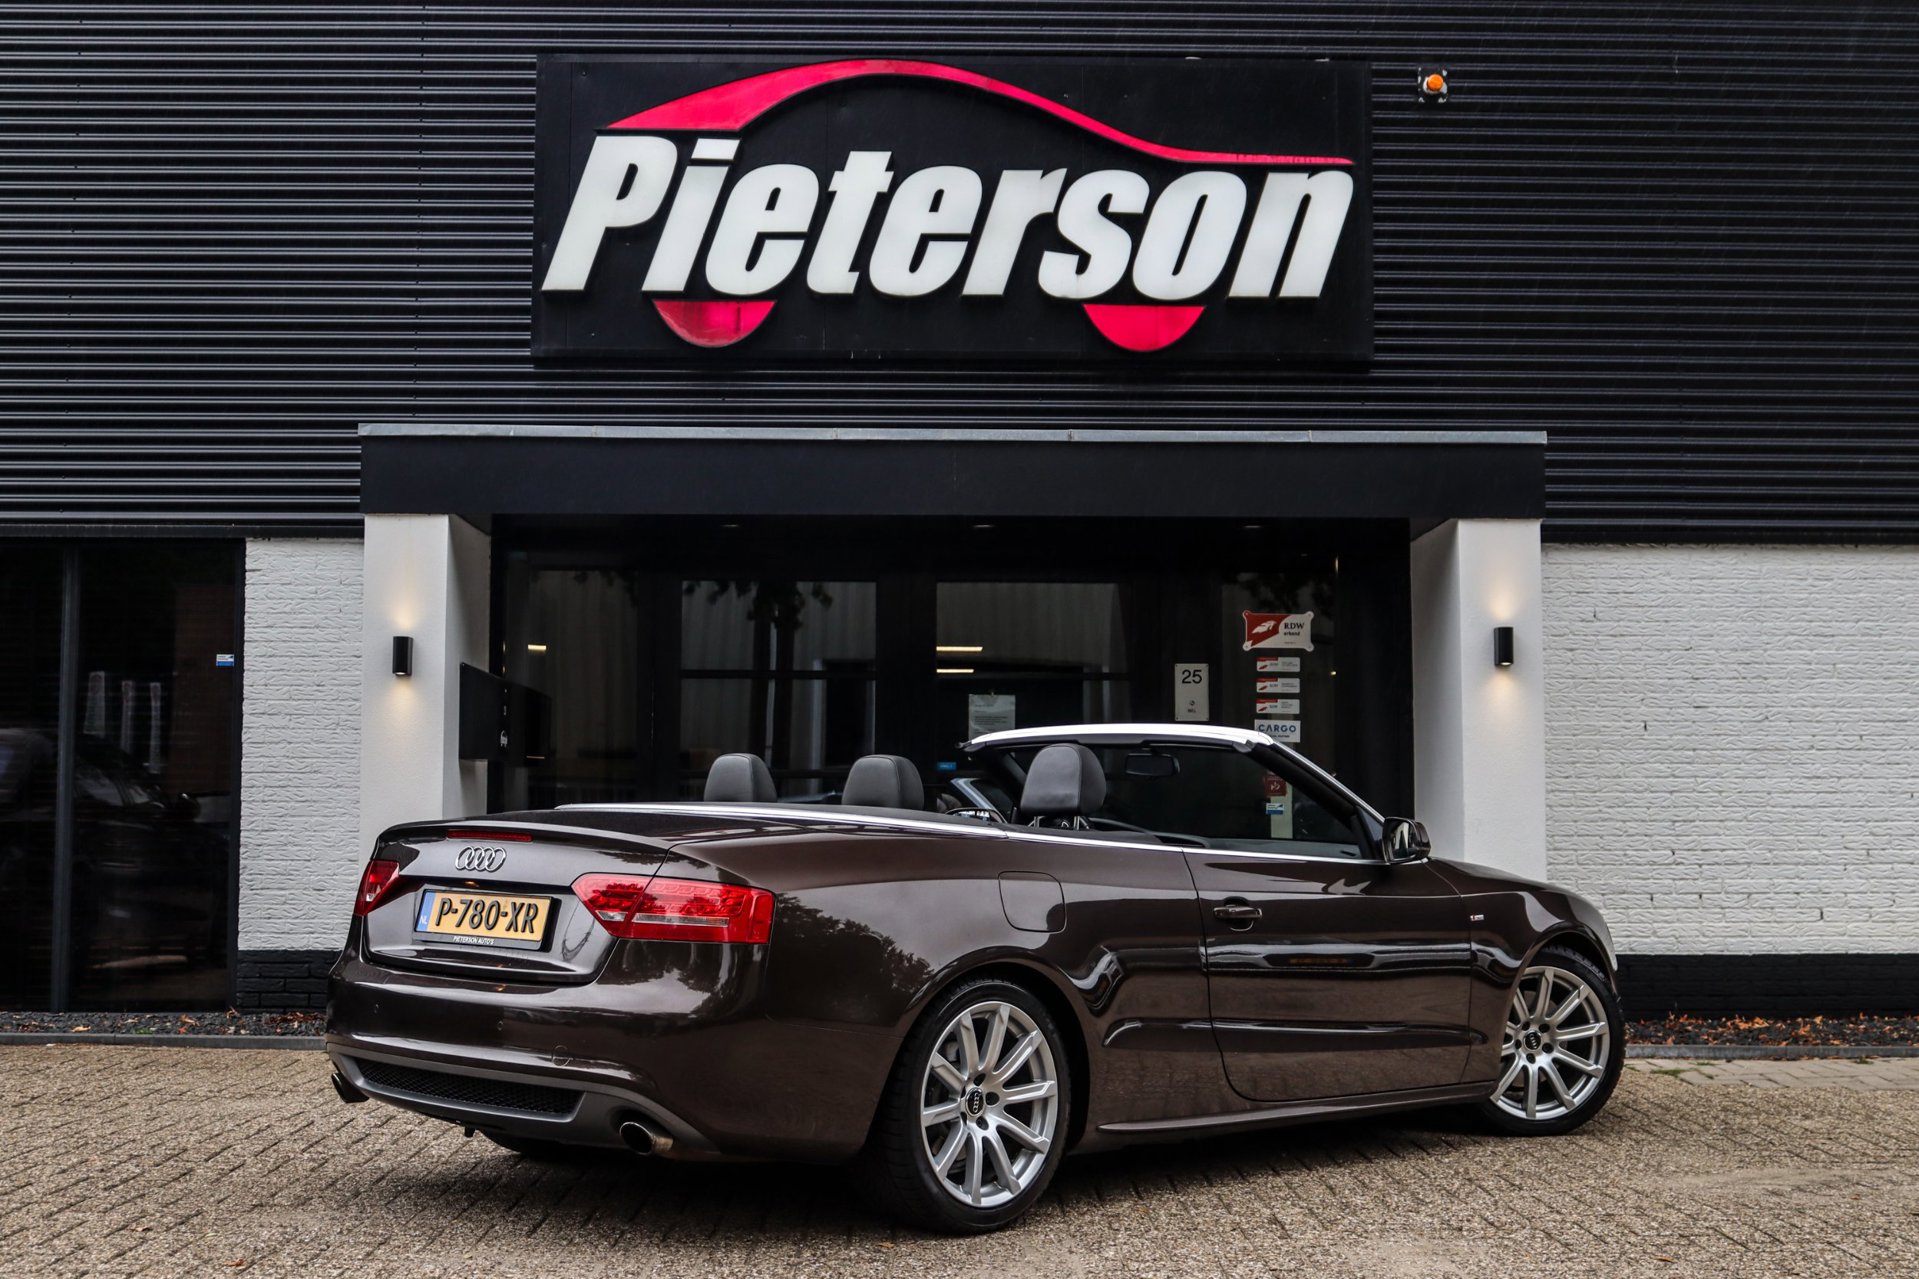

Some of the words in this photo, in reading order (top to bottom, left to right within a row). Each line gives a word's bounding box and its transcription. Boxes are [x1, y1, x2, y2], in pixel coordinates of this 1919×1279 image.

[541, 135, 1354, 299] Pieterson
[1284, 622, 1304, 630] RDW
[1182, 669, 1203, 684] 25
[1258, 724, 1297, 732] CARGO
[435, 897, 539, 934] P-780-XR
